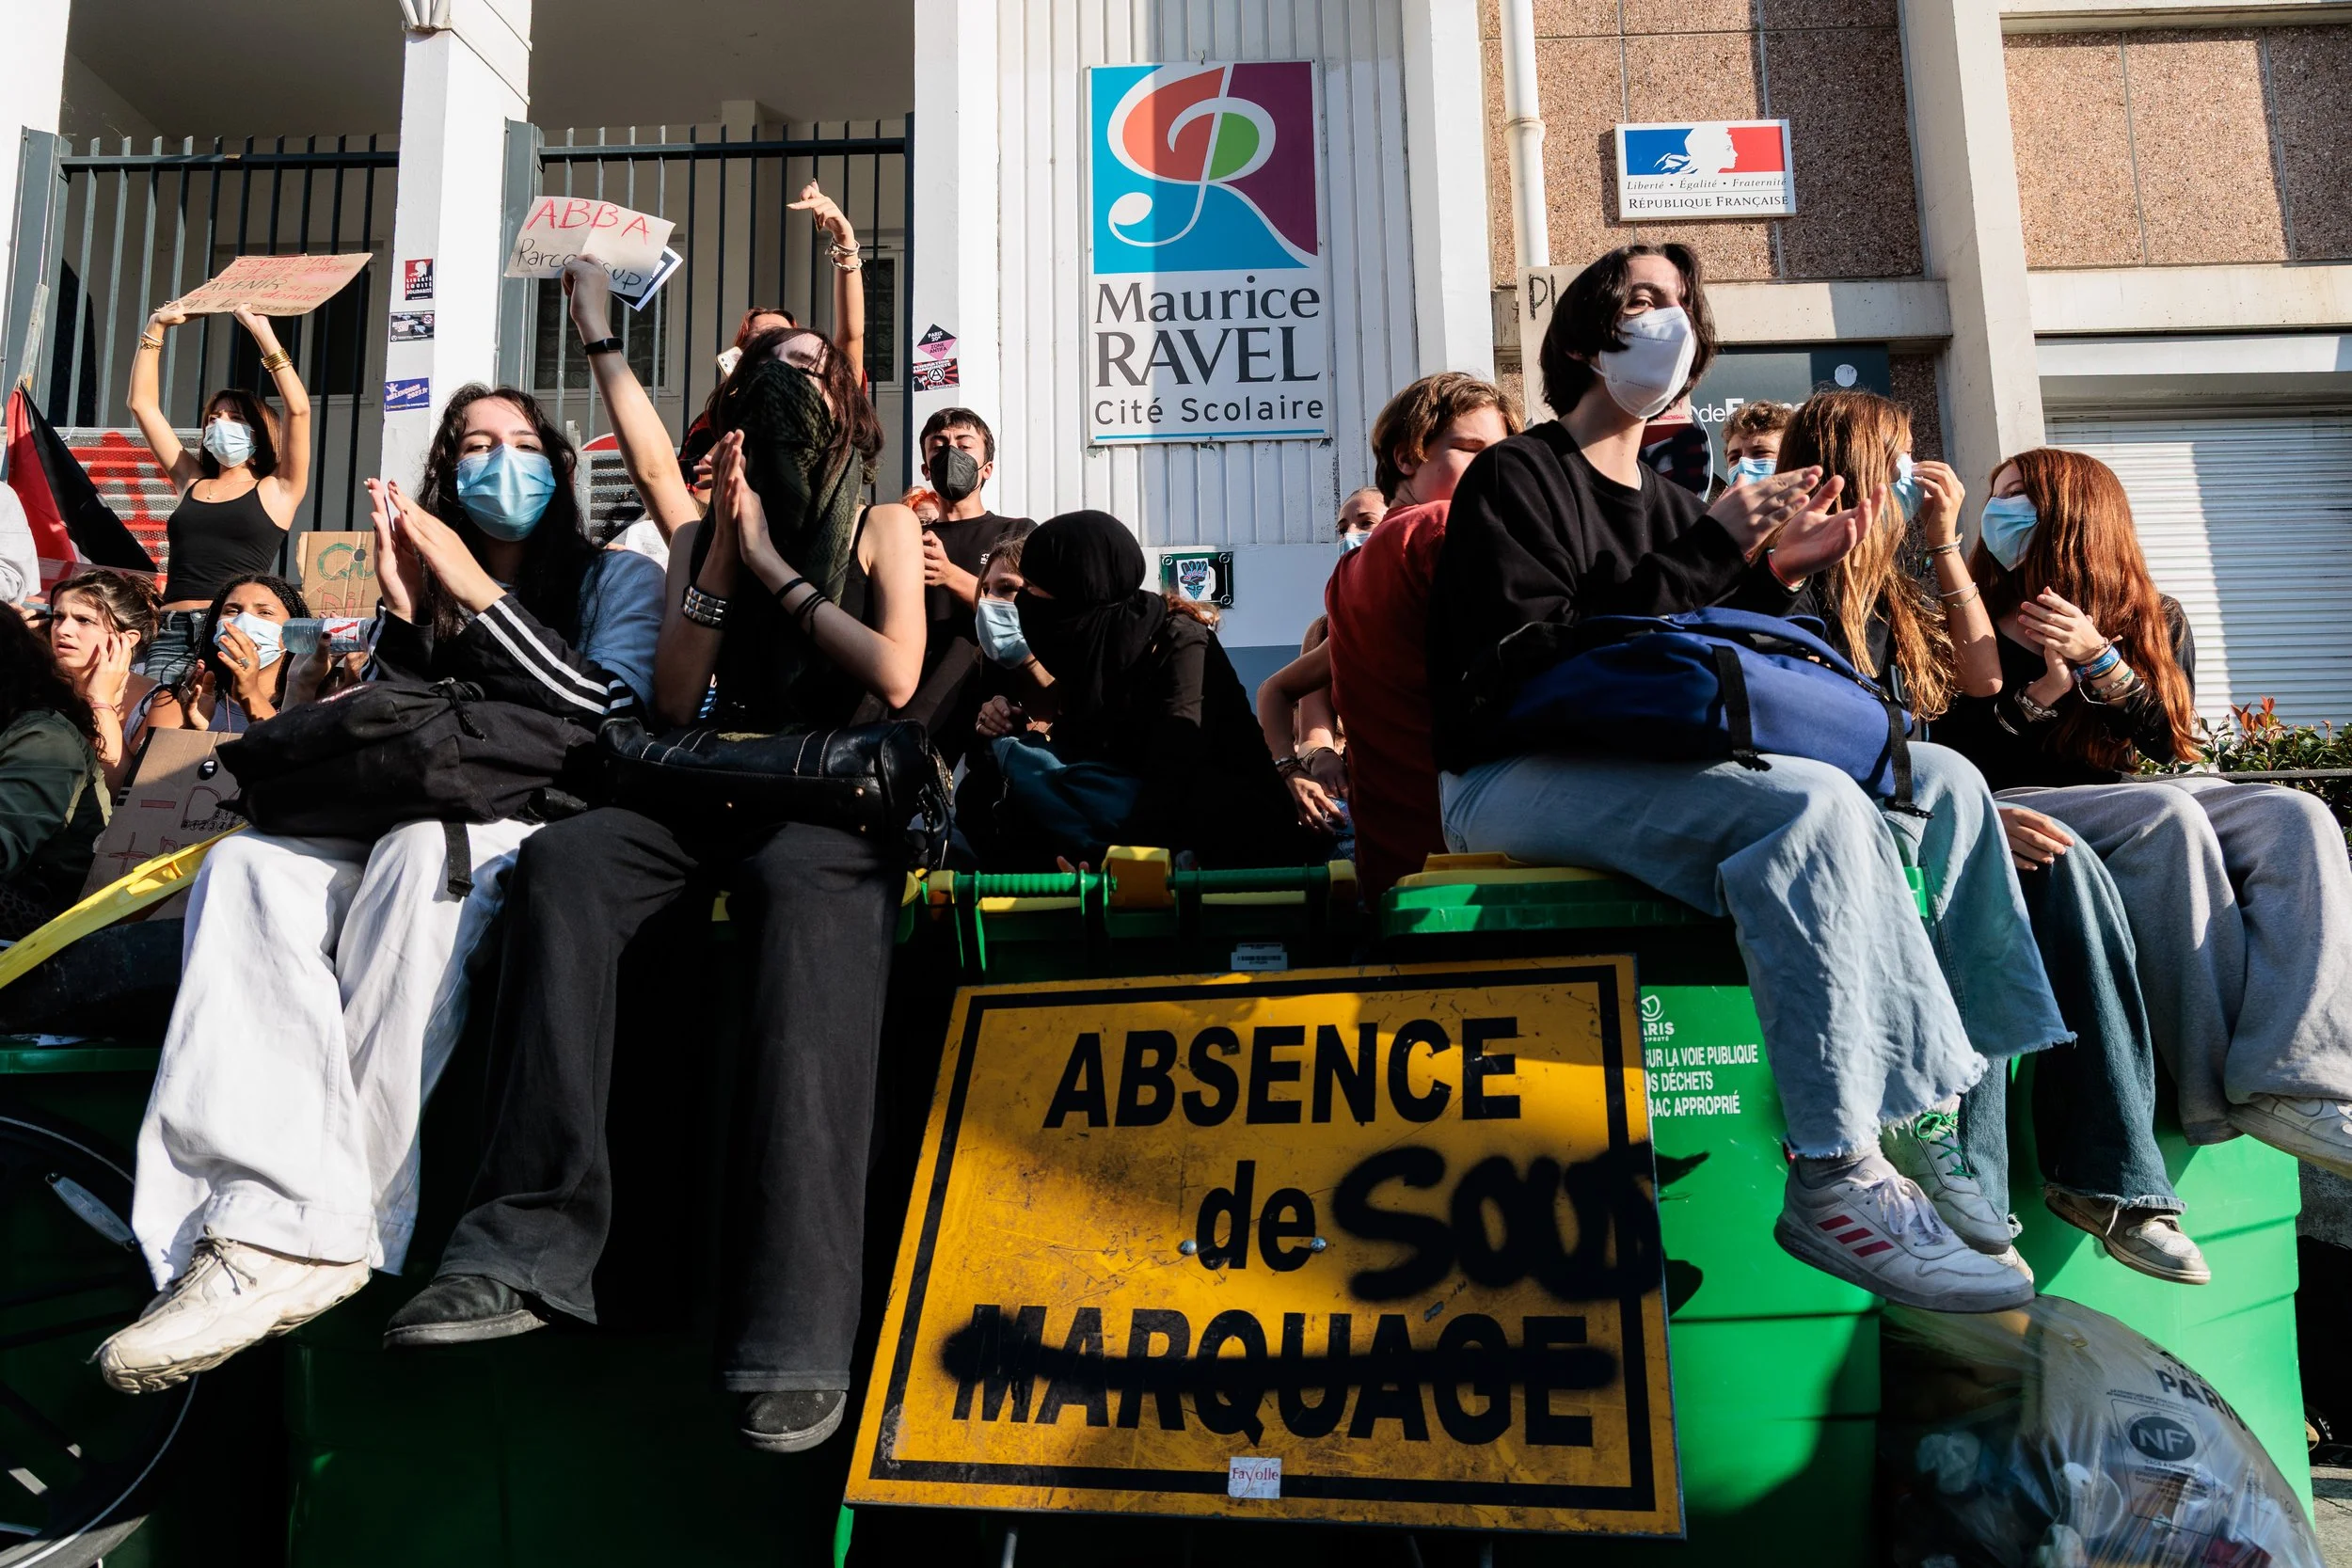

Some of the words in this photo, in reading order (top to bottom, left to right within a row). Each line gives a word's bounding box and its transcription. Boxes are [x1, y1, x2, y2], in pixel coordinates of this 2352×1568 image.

[1627, 181, 1665, 190] Liberté
[1679, 178, 1717, 189] Égalité
[1732, 178, 1787, 187] Fraternité
[1629, 197, 1712, 209] RÉPUBLIQUE
[1716, 196, 1789, 208] FRANÇAISE
[526, 198, 650, 245] ABBA
[1095, 275, 1320, 324] Maurice
[1095, 325, 1321, 387] RAVEL
[1095, 397, 1164, 425] Cité
[1181, 394, 1324, 422] Scolaire
[1665, 1048, 1679, 1067] LA
[1680, 1047, 1706, 1066] VOIE
[1707, 1044, 1759, 1065] PUBLIQUE
[1042, 1017, 1523, 1129] ABSENCE
[1661, 1067, 1714, 1092] DÉCHETS
[1674, 1090, 1741, 1117] APPROPRIÉ
[1196, 1161, 1316, 1272] de
[952, 1304, 1595, 1447] MARQUAGE
[2137, 1427, 2191, 1456] NF
